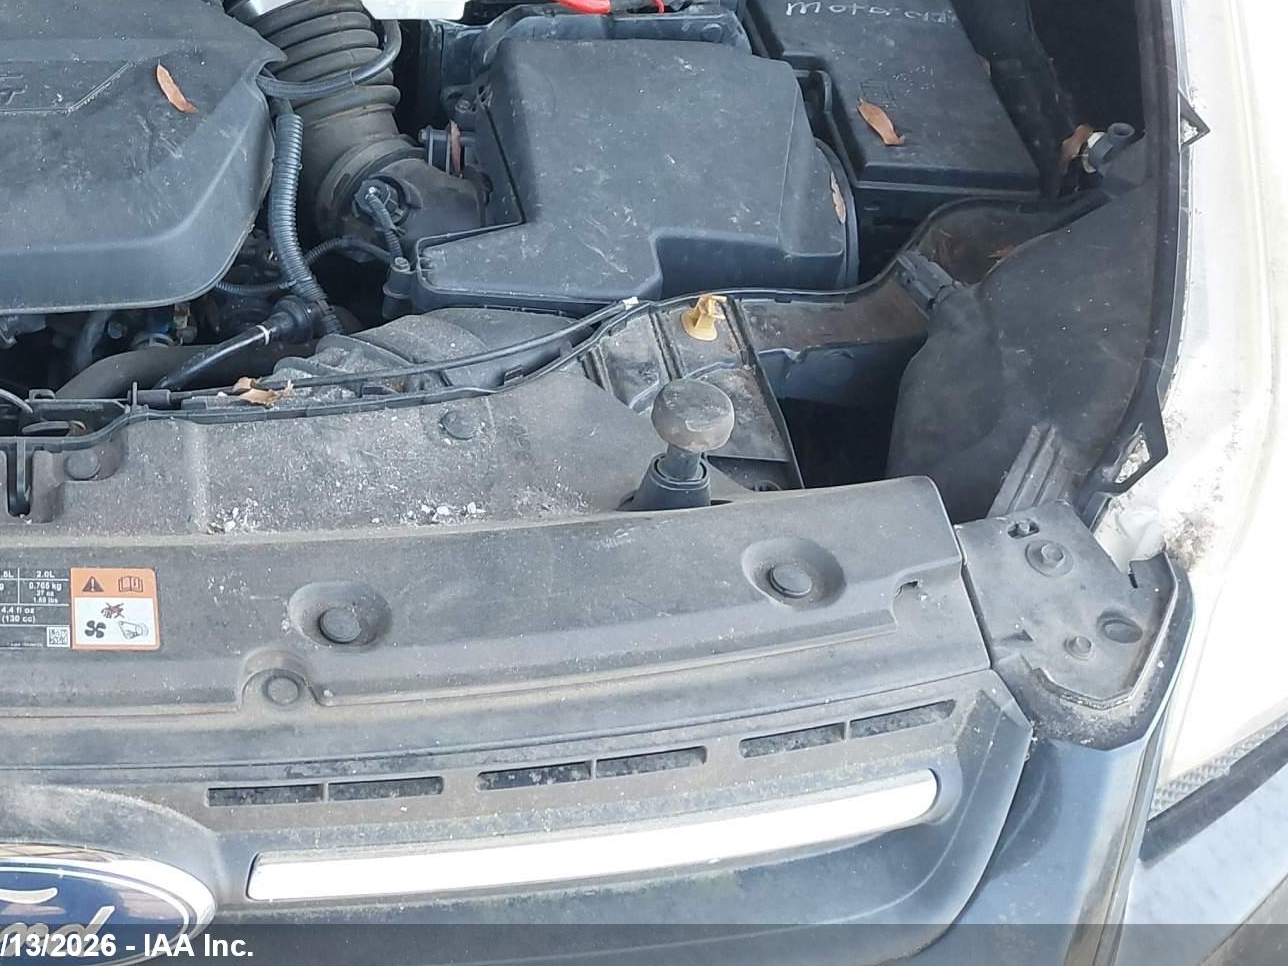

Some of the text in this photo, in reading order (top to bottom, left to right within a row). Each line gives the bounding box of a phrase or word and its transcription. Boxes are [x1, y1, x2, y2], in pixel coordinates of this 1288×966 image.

[36, 570, 55, 578] 2.0L
[52, 582, 62, 591] kg
[0, 606, 14, 614] 4.4
[1, 615, 36, 623] (130 cc)
